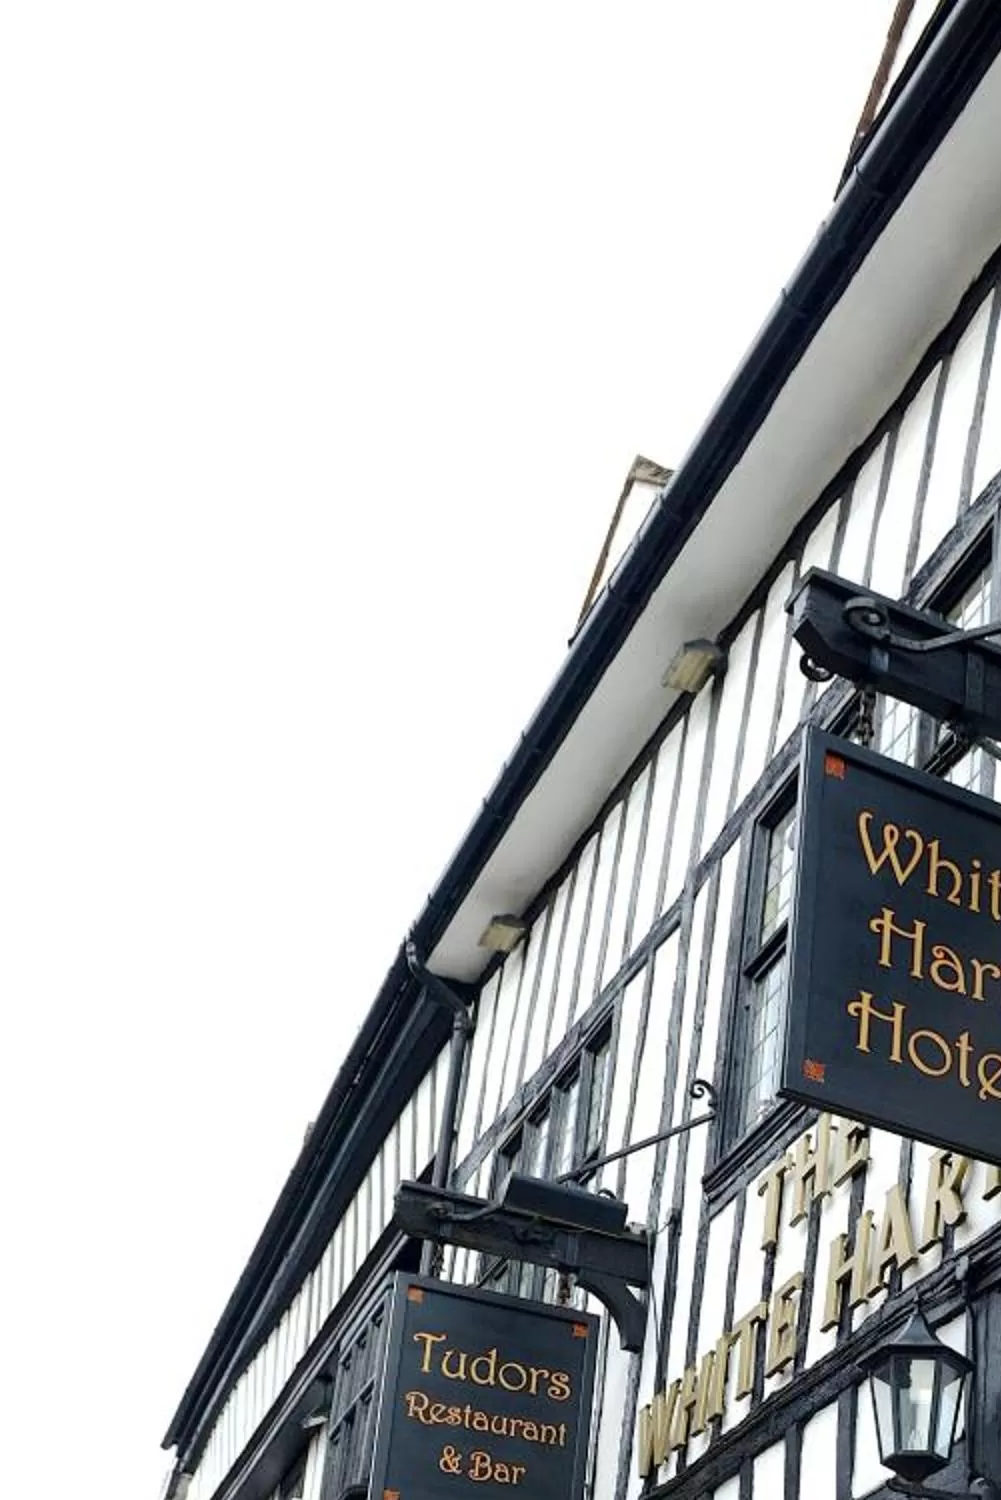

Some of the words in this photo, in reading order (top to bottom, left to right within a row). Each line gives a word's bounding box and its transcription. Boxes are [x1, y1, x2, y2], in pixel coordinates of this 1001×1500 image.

[757, 1112, 872, 1251] THE
[413, 1333, 571, 1401] Tudors
[639, 1271, 804, 1478] WHITE
[405, 1391, 567, 1447] Restaurant
[439, 1445, 462, 1475] &
[468, 1451, 526, 1485] Bar
